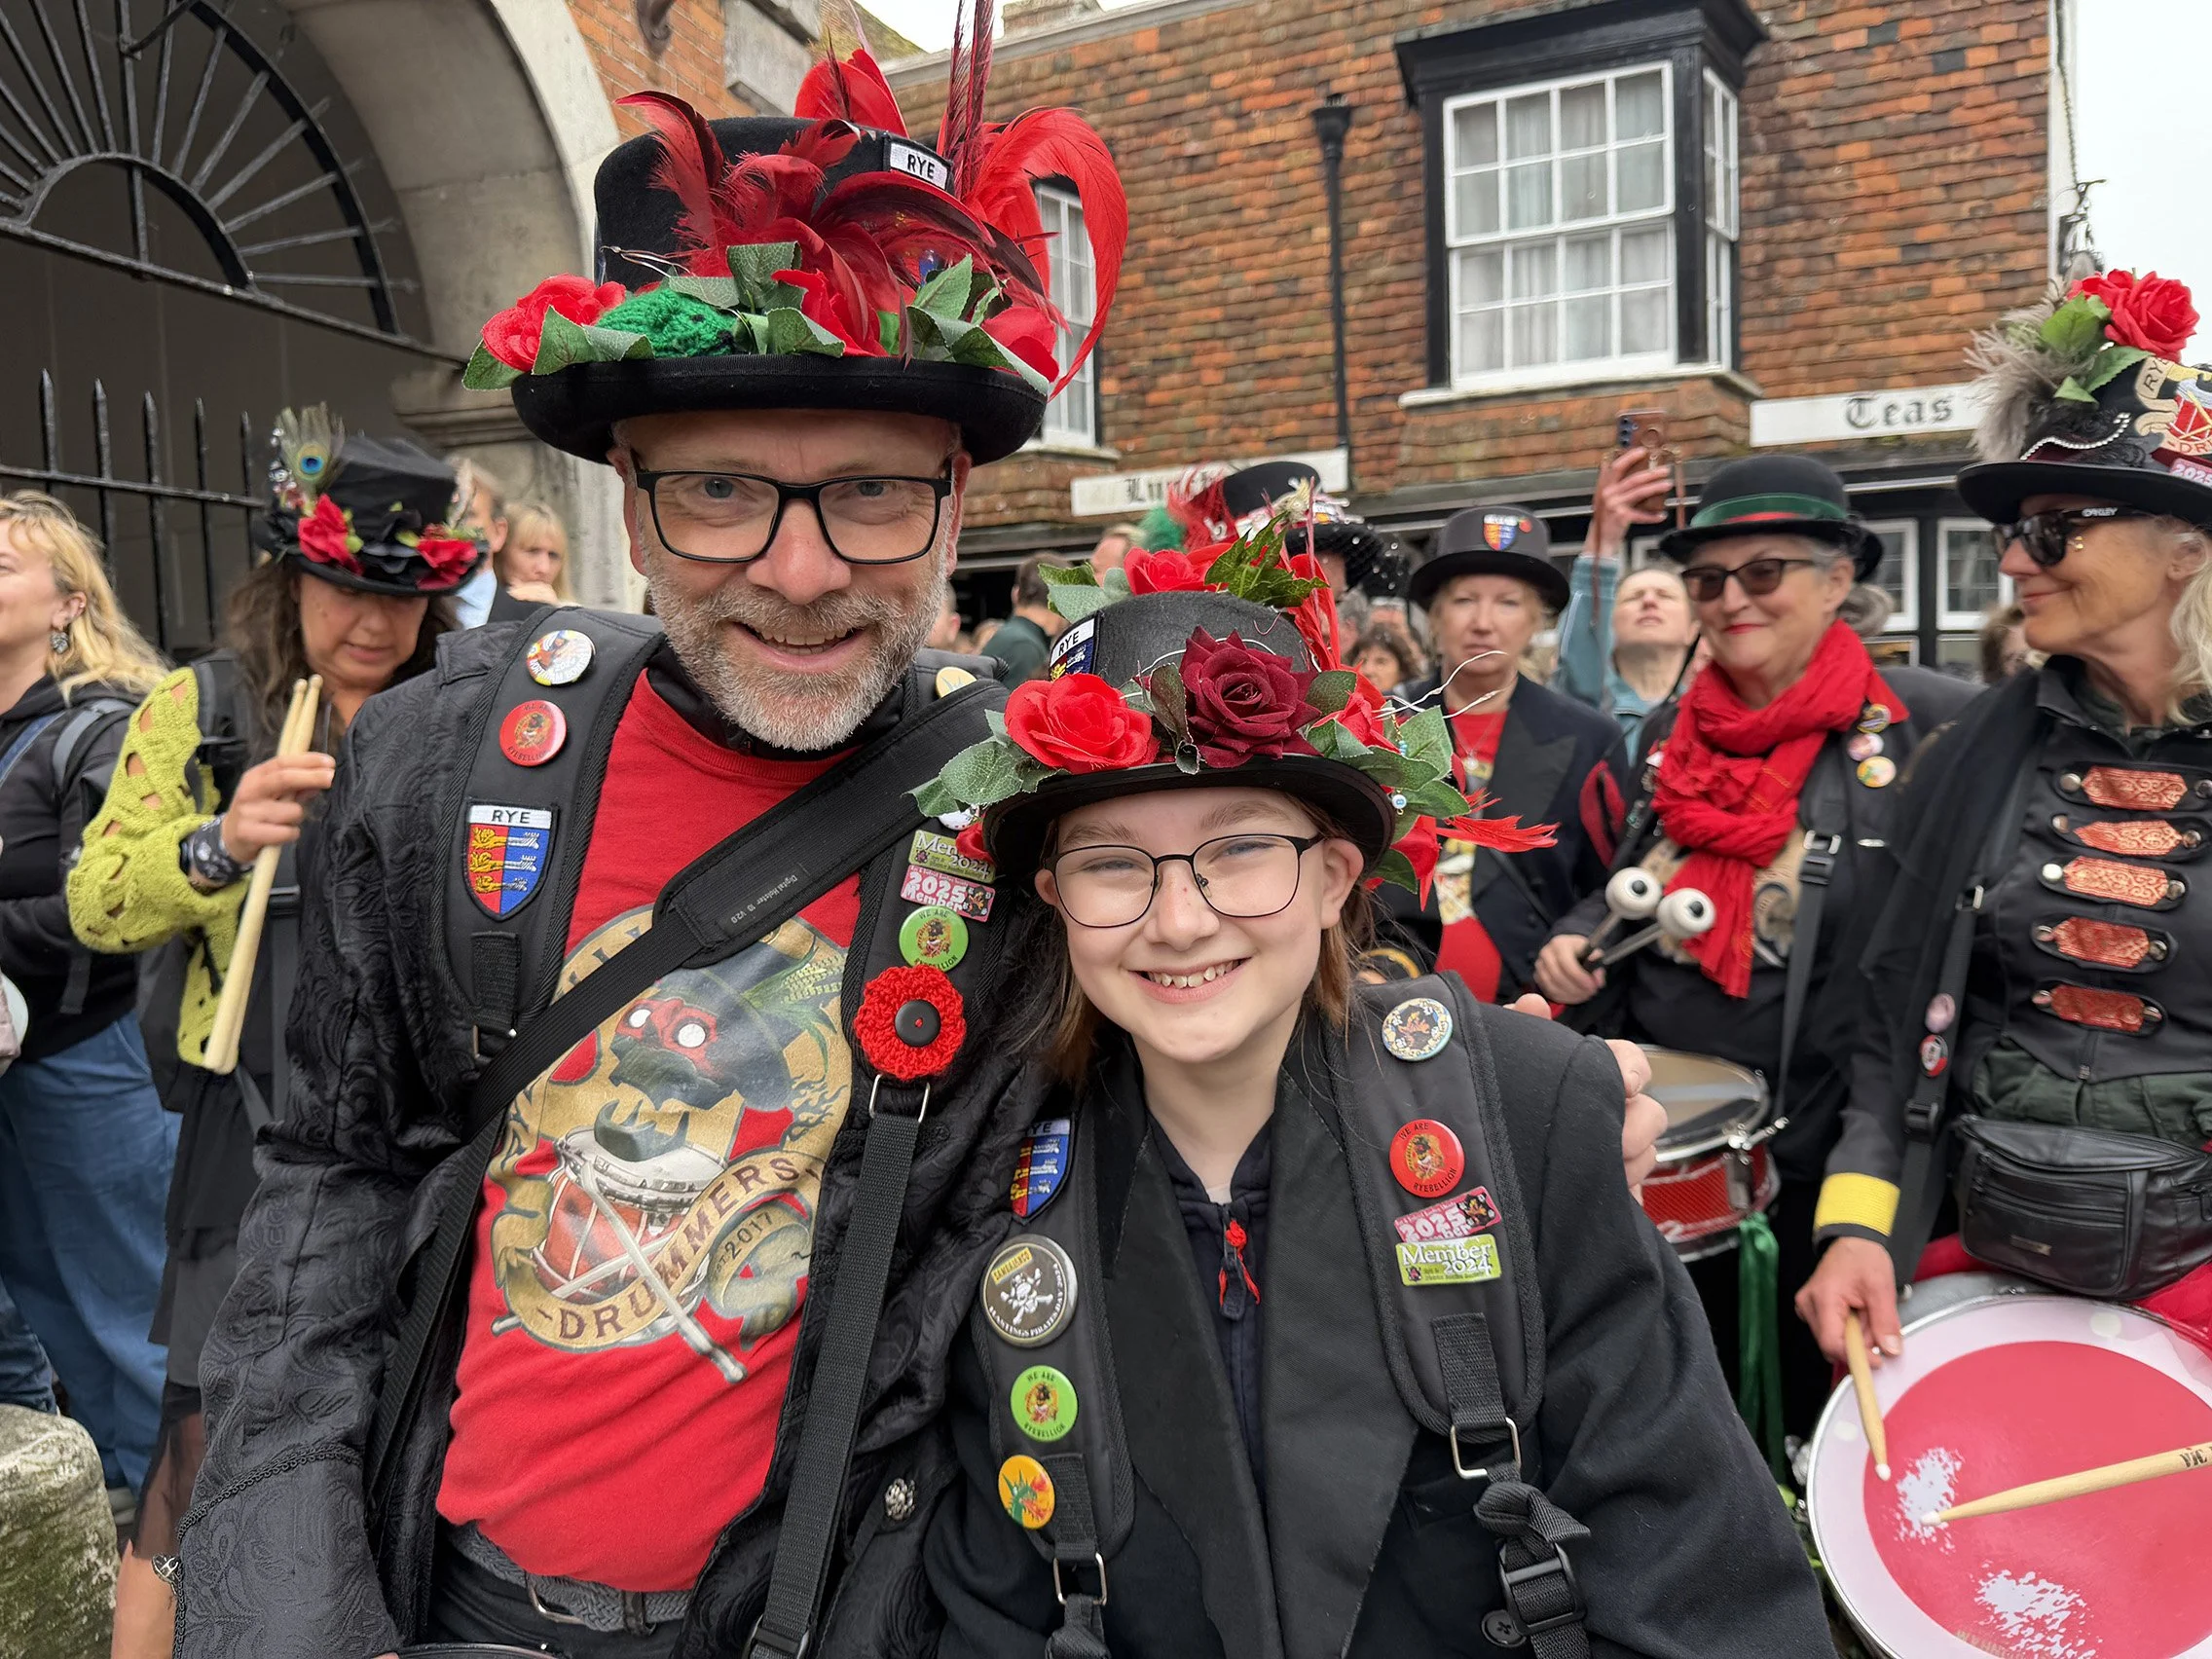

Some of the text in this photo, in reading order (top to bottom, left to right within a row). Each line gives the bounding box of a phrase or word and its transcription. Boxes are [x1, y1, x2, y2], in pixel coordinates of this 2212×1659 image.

[907, 154, 936, 179] RYE
[1846, 391, 1954, 429] Teas
[1058, 631, 1080, 656] RYE
[492, 810, 531, 824] RYE
[948, 855, 990, 879] 2024
[902, 884, 967, 912] Member
[909, 870, 967, 903] 2025
[918, 909, 948, 920] WE ARE
[1399, 1127, 1412, 1140] WE
[1413, 1167, 1457, 1193] RYEBELLION
[724, 1211, 773, 1259] 2017
[1399, 1206, 1467, 1242] 2025
[559, 1158, 800, 1340] DRUMMERS
[1401, 1241, 1492, 1265] Member
[1442, 1254, 1492, 1277] 2024
[989, 1306, 1029, 1337] HASTINGS
[1030, 1311, 1057, 1337] PIRATES
